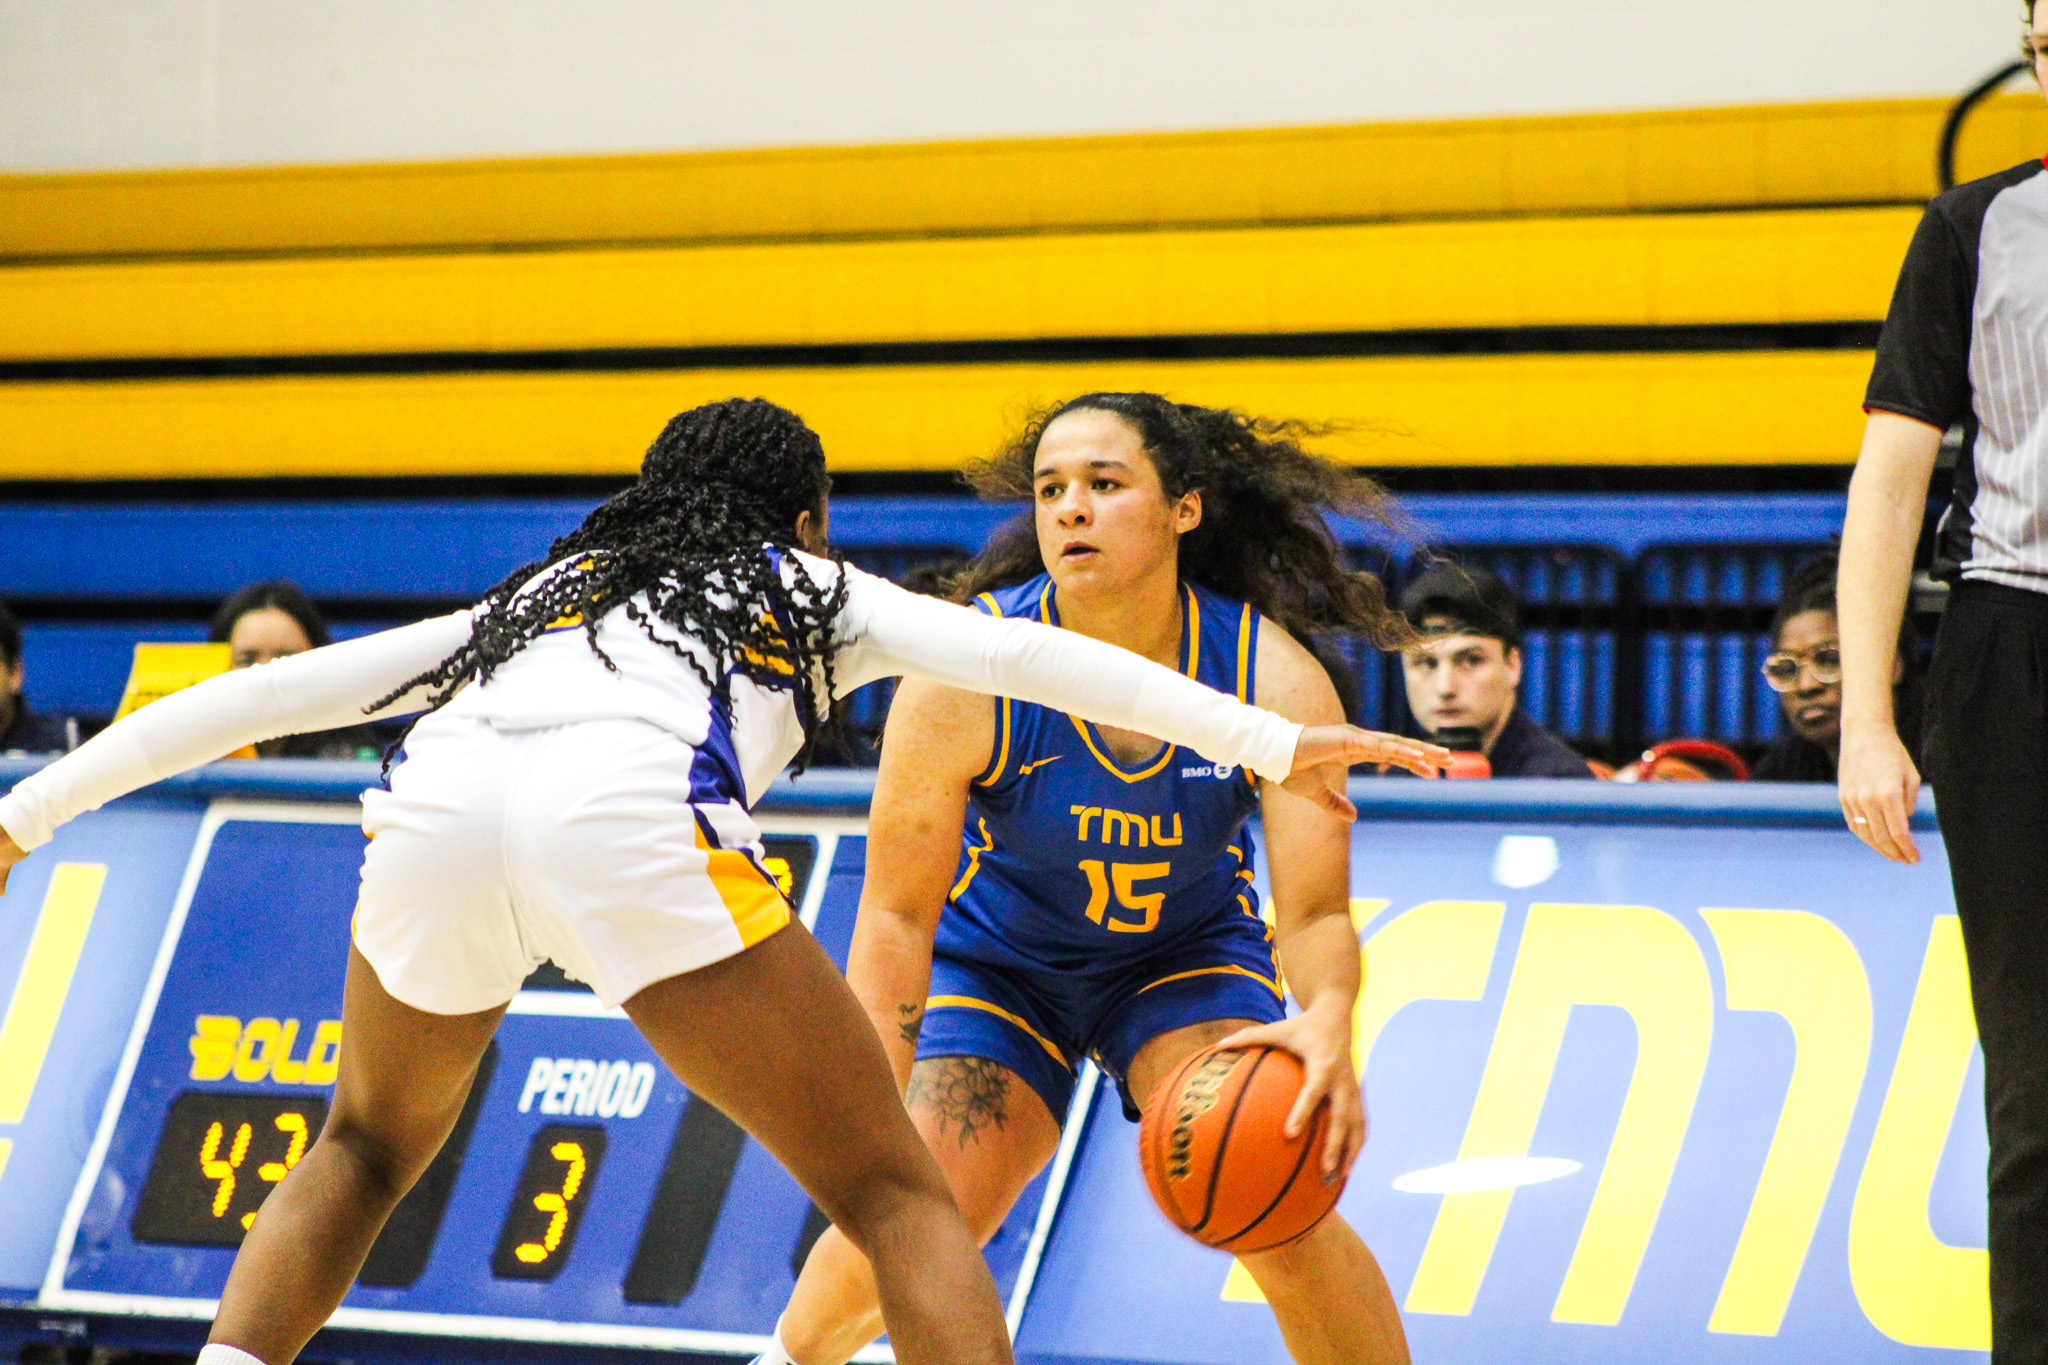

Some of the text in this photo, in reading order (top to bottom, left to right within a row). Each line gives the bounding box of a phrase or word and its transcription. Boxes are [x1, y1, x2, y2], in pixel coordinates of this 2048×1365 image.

[1070, 804, 1183, 848] TMU
[1078, 859, 1171, 933] 15
[190, 1014, 343, 1085] BOLD
[517, 1056, 656, 1119] PERIOD
[514, 1141, 586, 1263] 3
